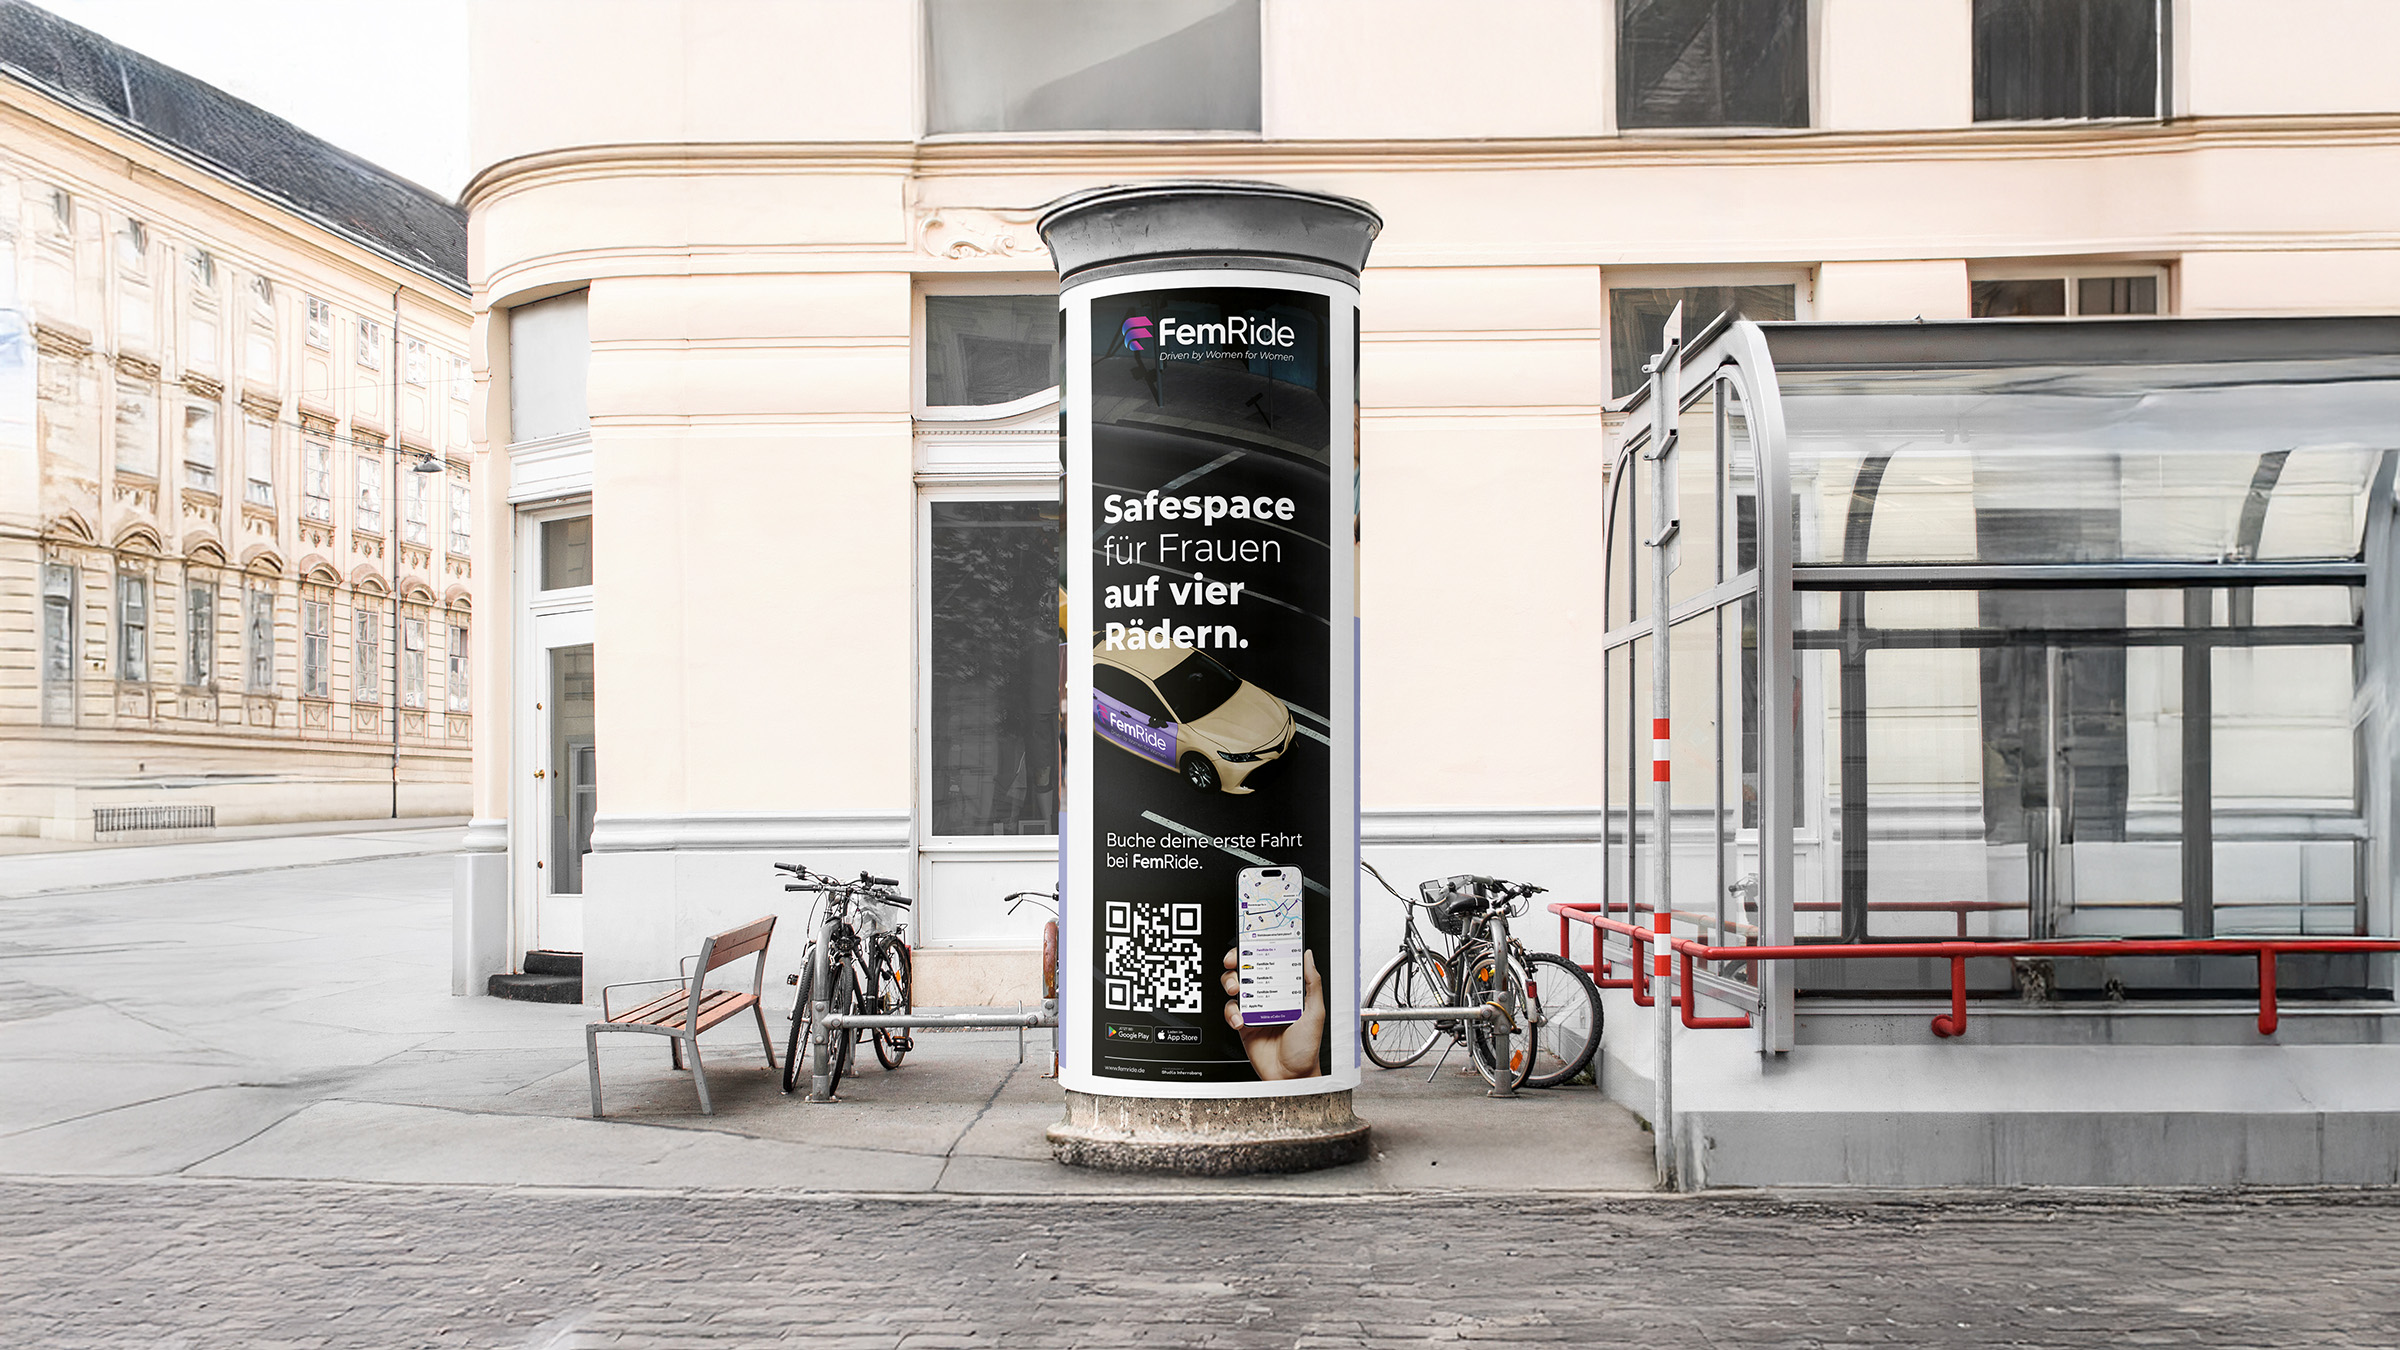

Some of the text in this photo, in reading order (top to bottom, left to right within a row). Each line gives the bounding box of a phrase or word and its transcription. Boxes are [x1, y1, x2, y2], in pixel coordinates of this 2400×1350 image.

[1159, 316, 1295, 348] FemRide
[1159, 350, 1295, 362] Driven by Women for Women
[1103, 489, 1295, 526] Safespace
[1103, 533, 1281, 566] für Frauen
[1104, 572, 1245, 609] auf vier
[1105, 618, 1249, 652] Rädern.
[1109, 712, 1167, 751] FemRide
[1106, 832, 1303, 849] Buche deine erste Fahrt
[1106, 853, 1203, 870] bei FemRide.
[1118, 1031, 1150, 1041] Google Play
[1167, 1034, 1199, 1042] App Store
